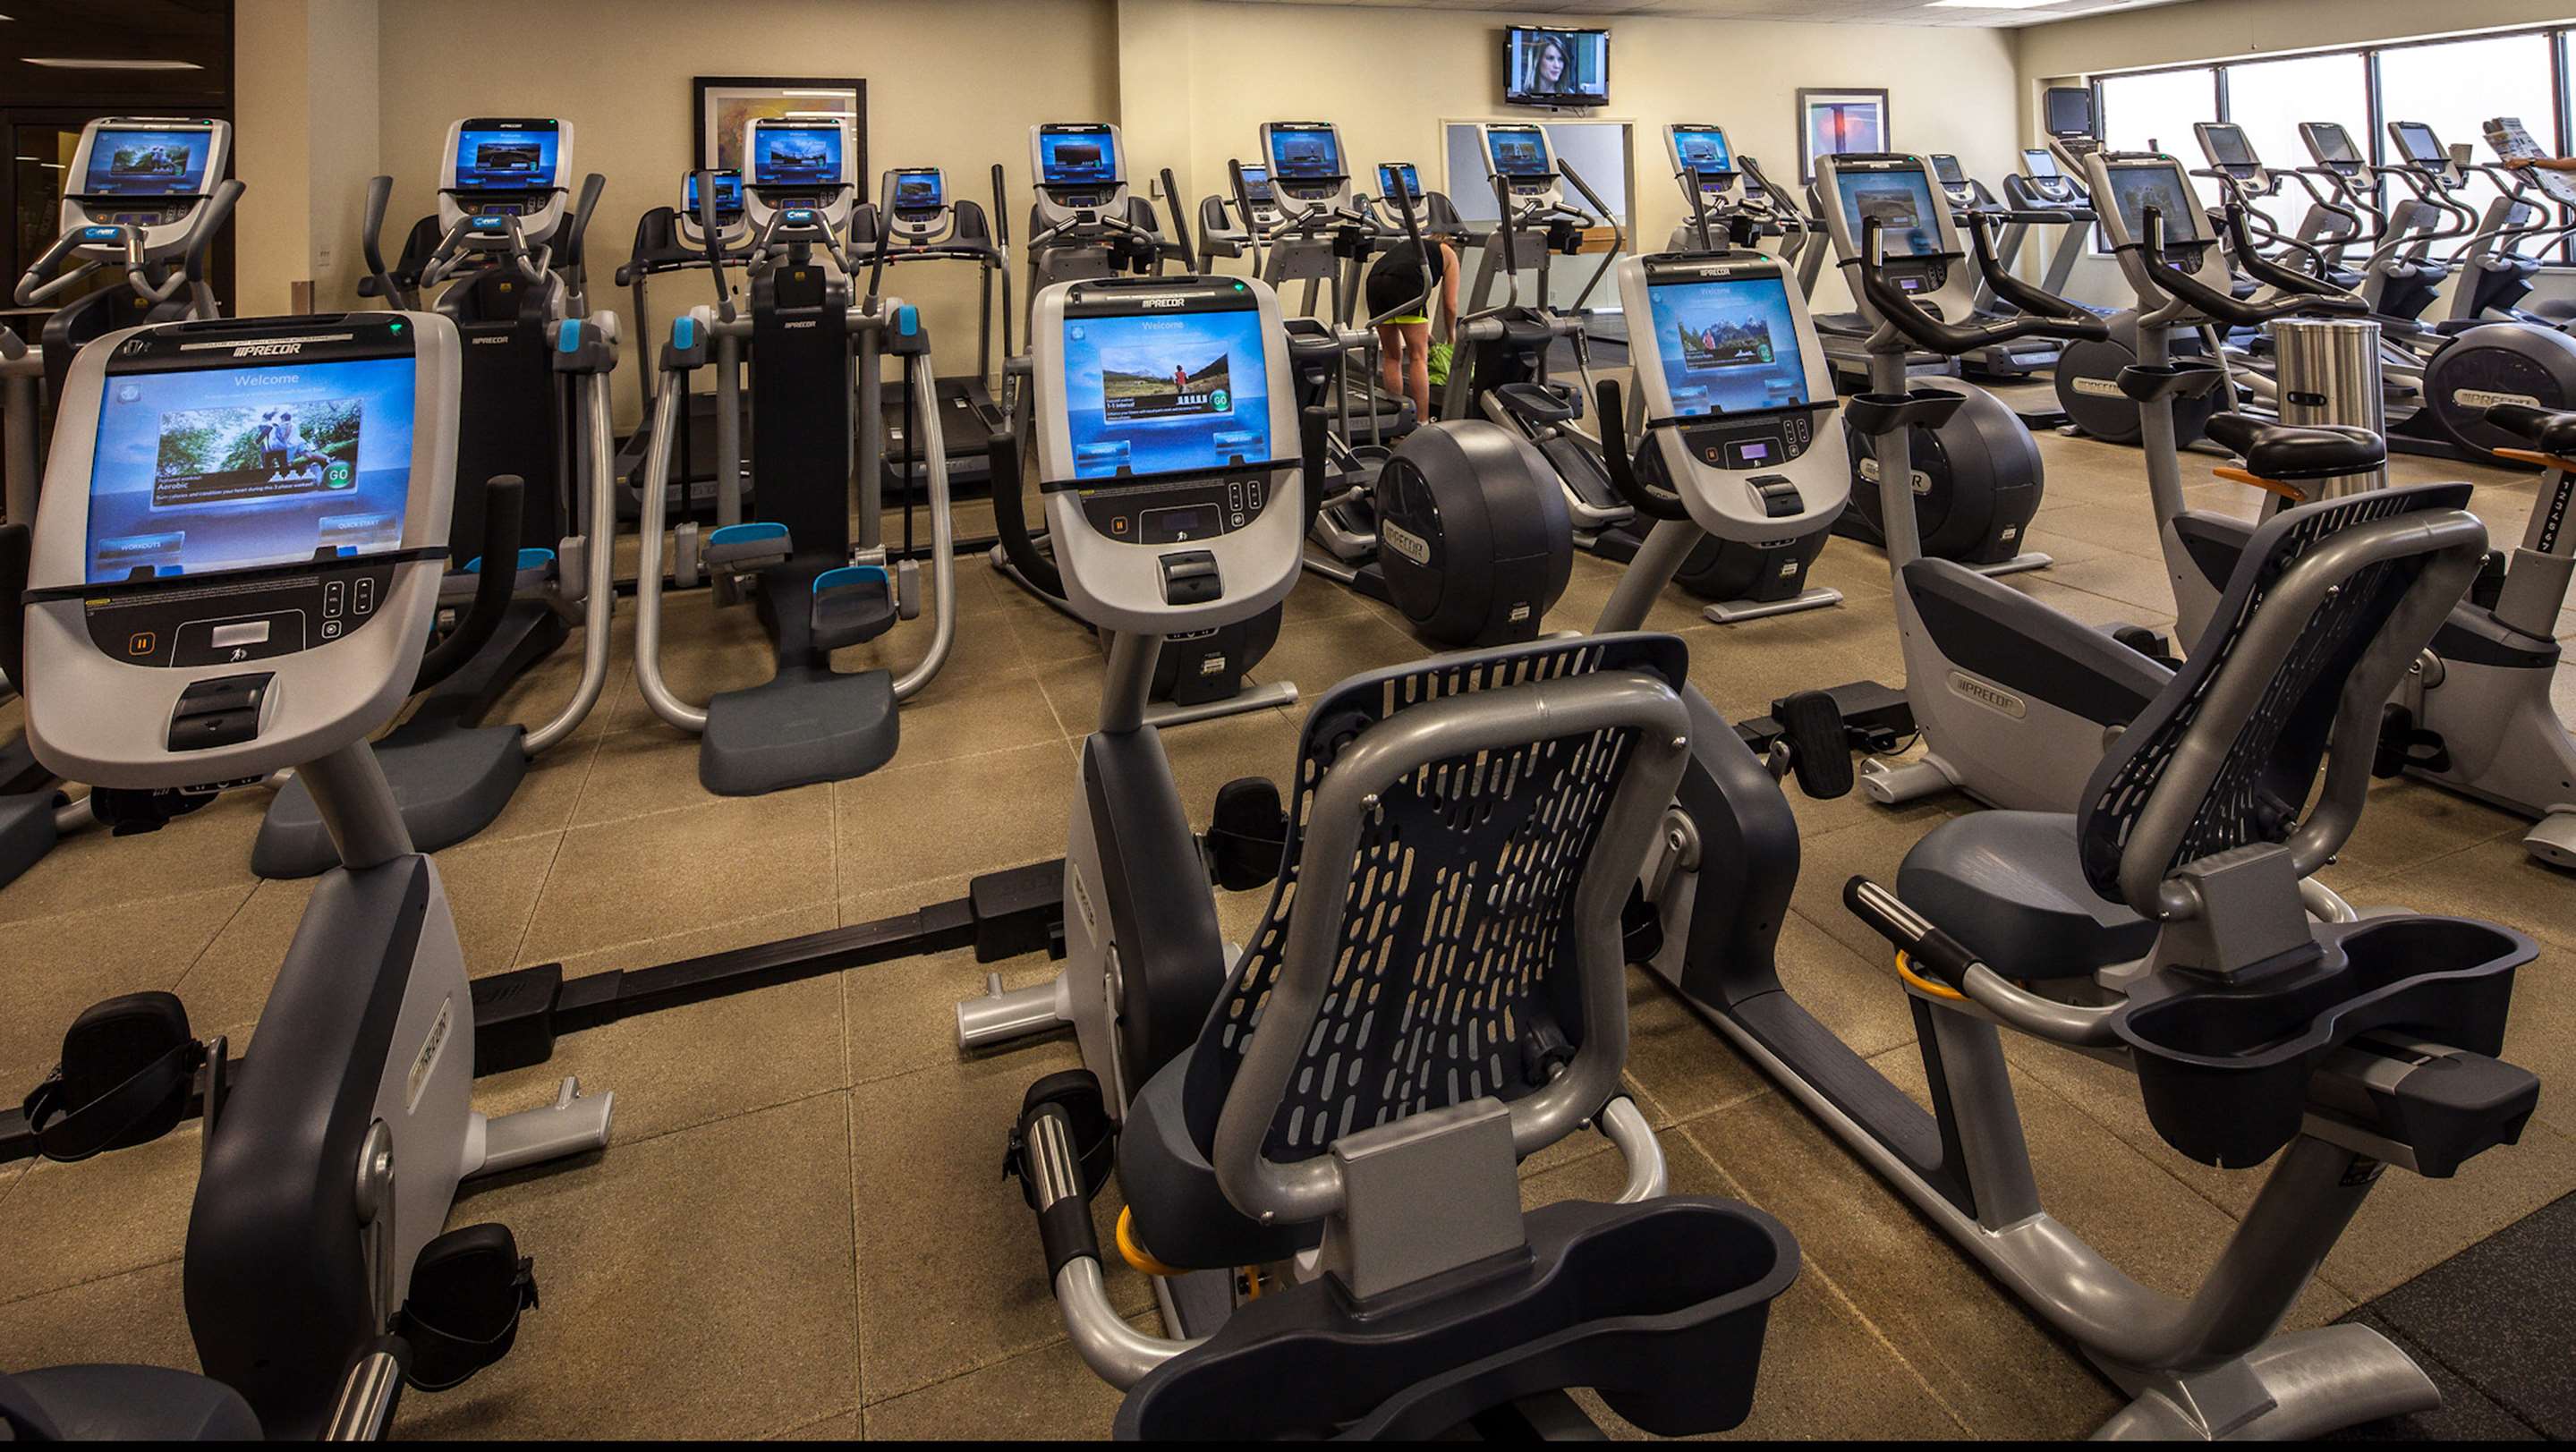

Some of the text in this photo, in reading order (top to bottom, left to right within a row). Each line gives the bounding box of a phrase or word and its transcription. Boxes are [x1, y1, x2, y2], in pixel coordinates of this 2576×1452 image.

[1148, 298, 1185, 308] PRECOR
[242, 343, 302, 356] PRECOR
[234, 374, 301, 386] Welcome
[329, 470, 348, 480] GO
[157, 482, 189, 490] Aerobic
[1966, 682, 2013, 709] PRECOR
